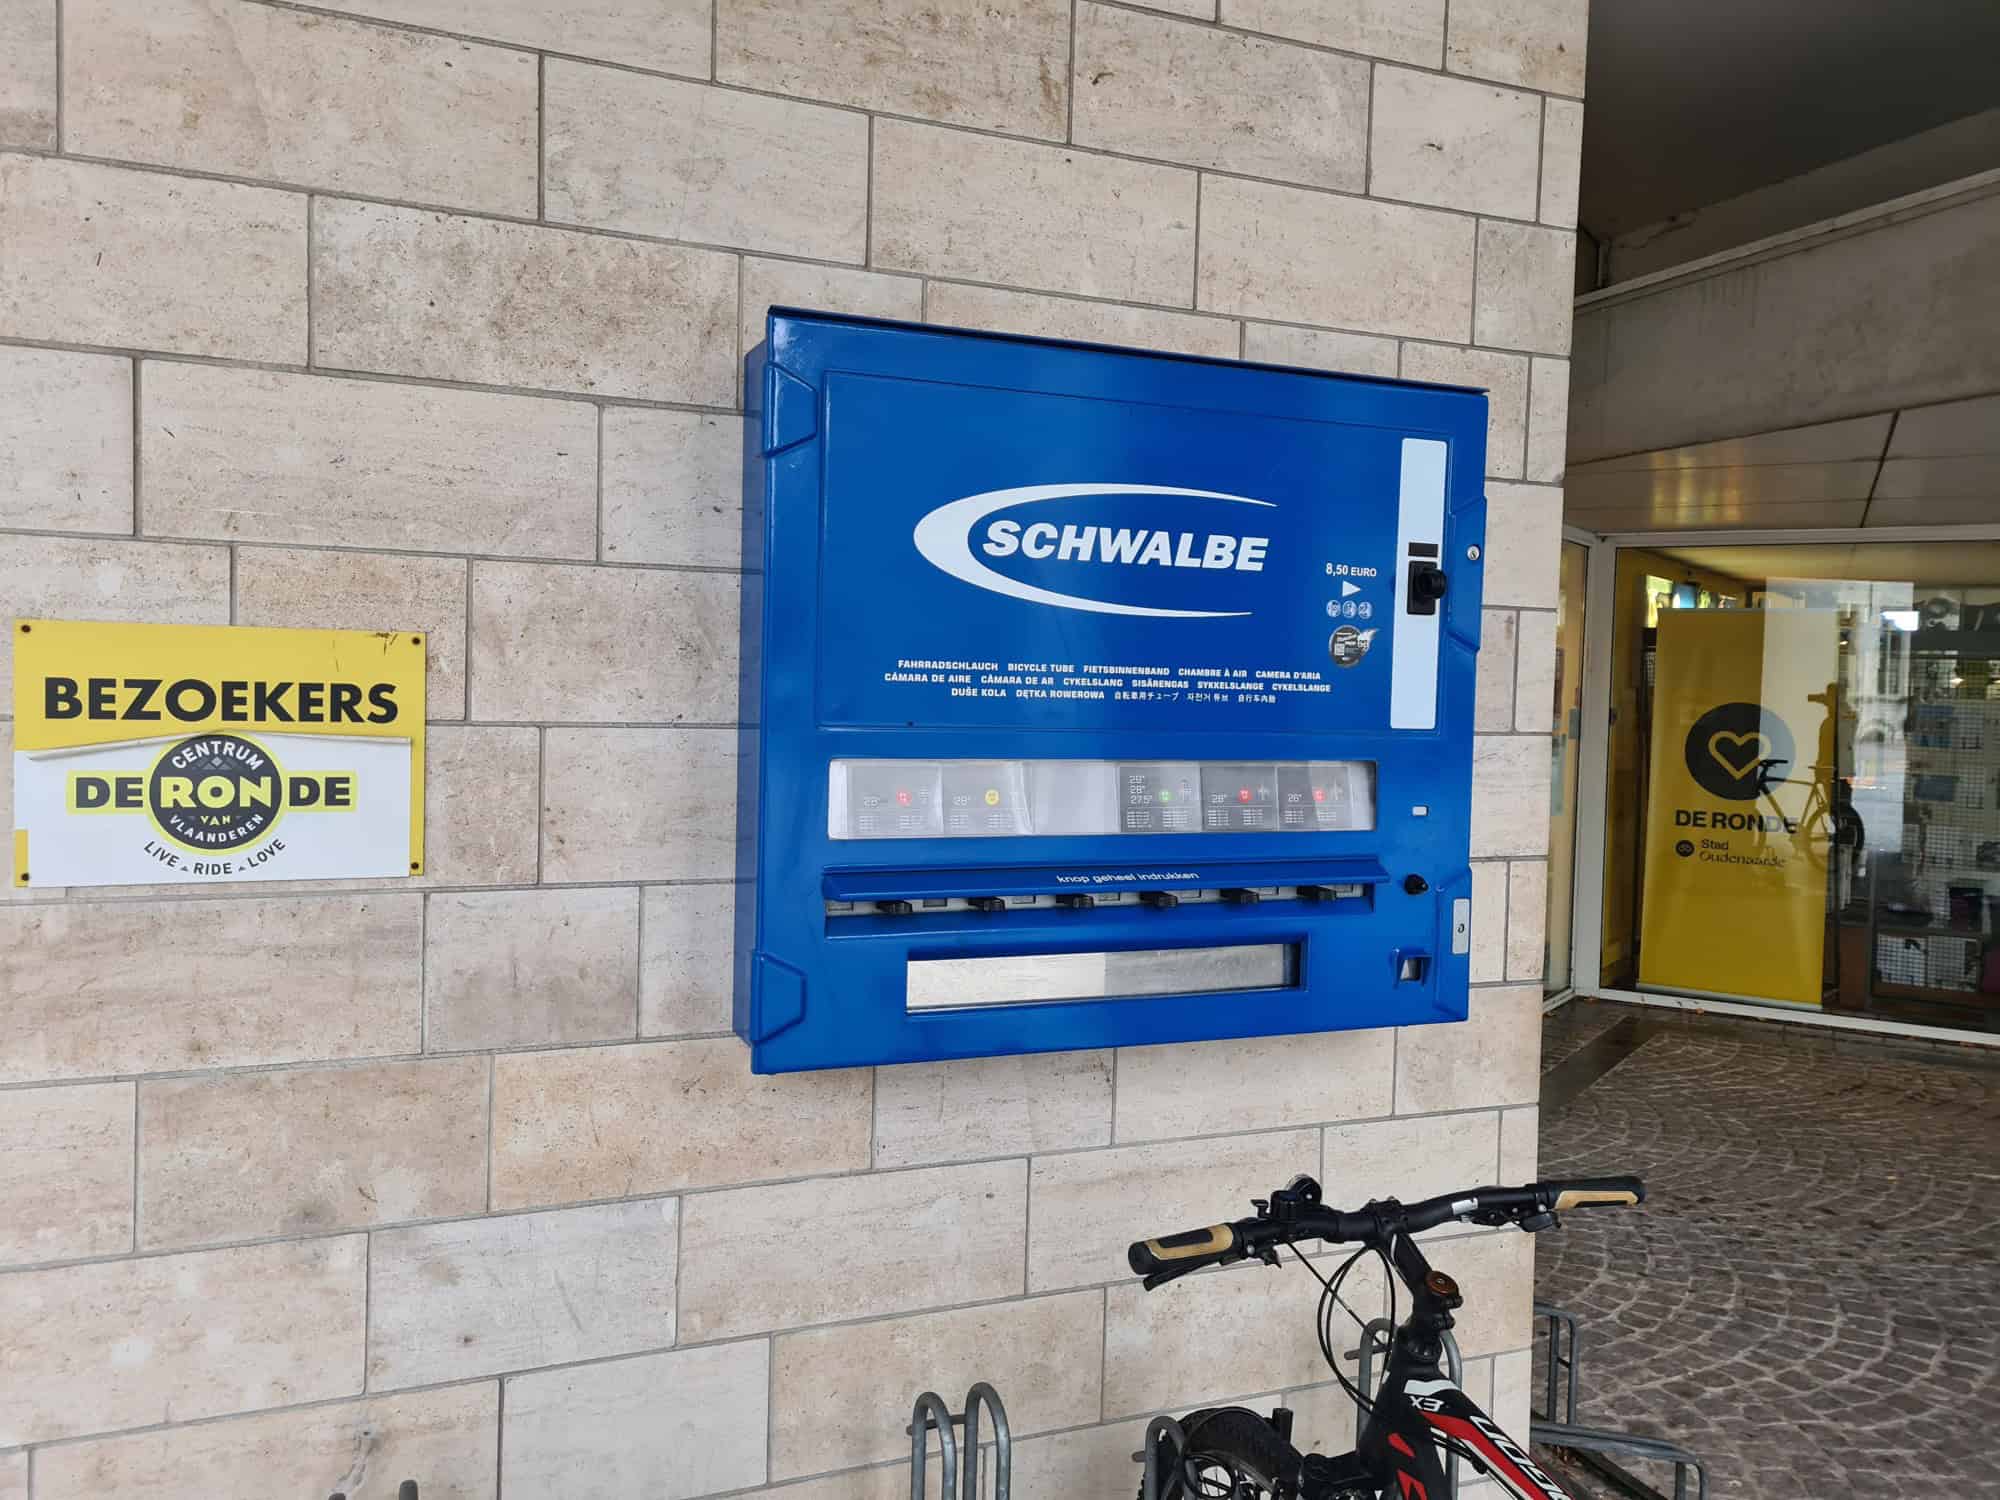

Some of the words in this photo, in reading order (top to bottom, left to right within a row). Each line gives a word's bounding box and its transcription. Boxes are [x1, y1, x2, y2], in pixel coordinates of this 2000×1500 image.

[982, 519, 1270, 572] SCHWALBE
[1325, 562, 1349, 576] 8,50
[1351, 566, 1377, 577] EURO
[897, 659, 999, 671] FAHRRADSCHLAUCH
[1007, 662, 1047, 673] BICYCLE
[1050, 664, 1075, 673] TUBE
[1083, 664, 1170, 676] FIETSBINNENBAND
[1178, 667, 1222, 678] CHAMBRE
[1232, 669, 1248, 678] AIR
[1255, 670, 1291, 680] CAMERA
[1293, 672, 1321, 681] D'ARIA
[884, 671, 929, 683] CÁMARA
[931, 674, 945, 683] DE
[948, 674, 972, 684] AIRE
[1025, 676, 1039, 685] DE
[1041, 676, 1054, 686] AR
[1063, 677, 1124, 688] CYKELSLANG
[1197, 680, 1265, 691] SYKKELSLANGE
[1271, 683, 1332, 693] CYKELSLANGE
[951, 686, 978, 697] DUŠE
[981, 688, 1007, 697] KOLA
[1015, 689, 1047, 700] DĘTKA
[1050, 690, 1105, 700] ROWEROWA
[44, 676, 399, 724] BEZOEKERS
[171, 740, 265, 772] CENTRUM
[75, 776, 143, 809] DE
[168, 813, 265, 844] VLAANDEREN
[200, 815, 232, 827] VAN
[1675, 809, 1707, 828] DE
[1711, 811, 1799, 834] RONDE
[1701, 838, 1729, 851] Stad
[143, 840, 179, 868] LIVE
[193, 862, 234, 876] RIDE
[247, 838, 287, 869] LOVE
[1093, 873, 1136, 884] geheel
[1409, 1395, 1445, 1412] X3
